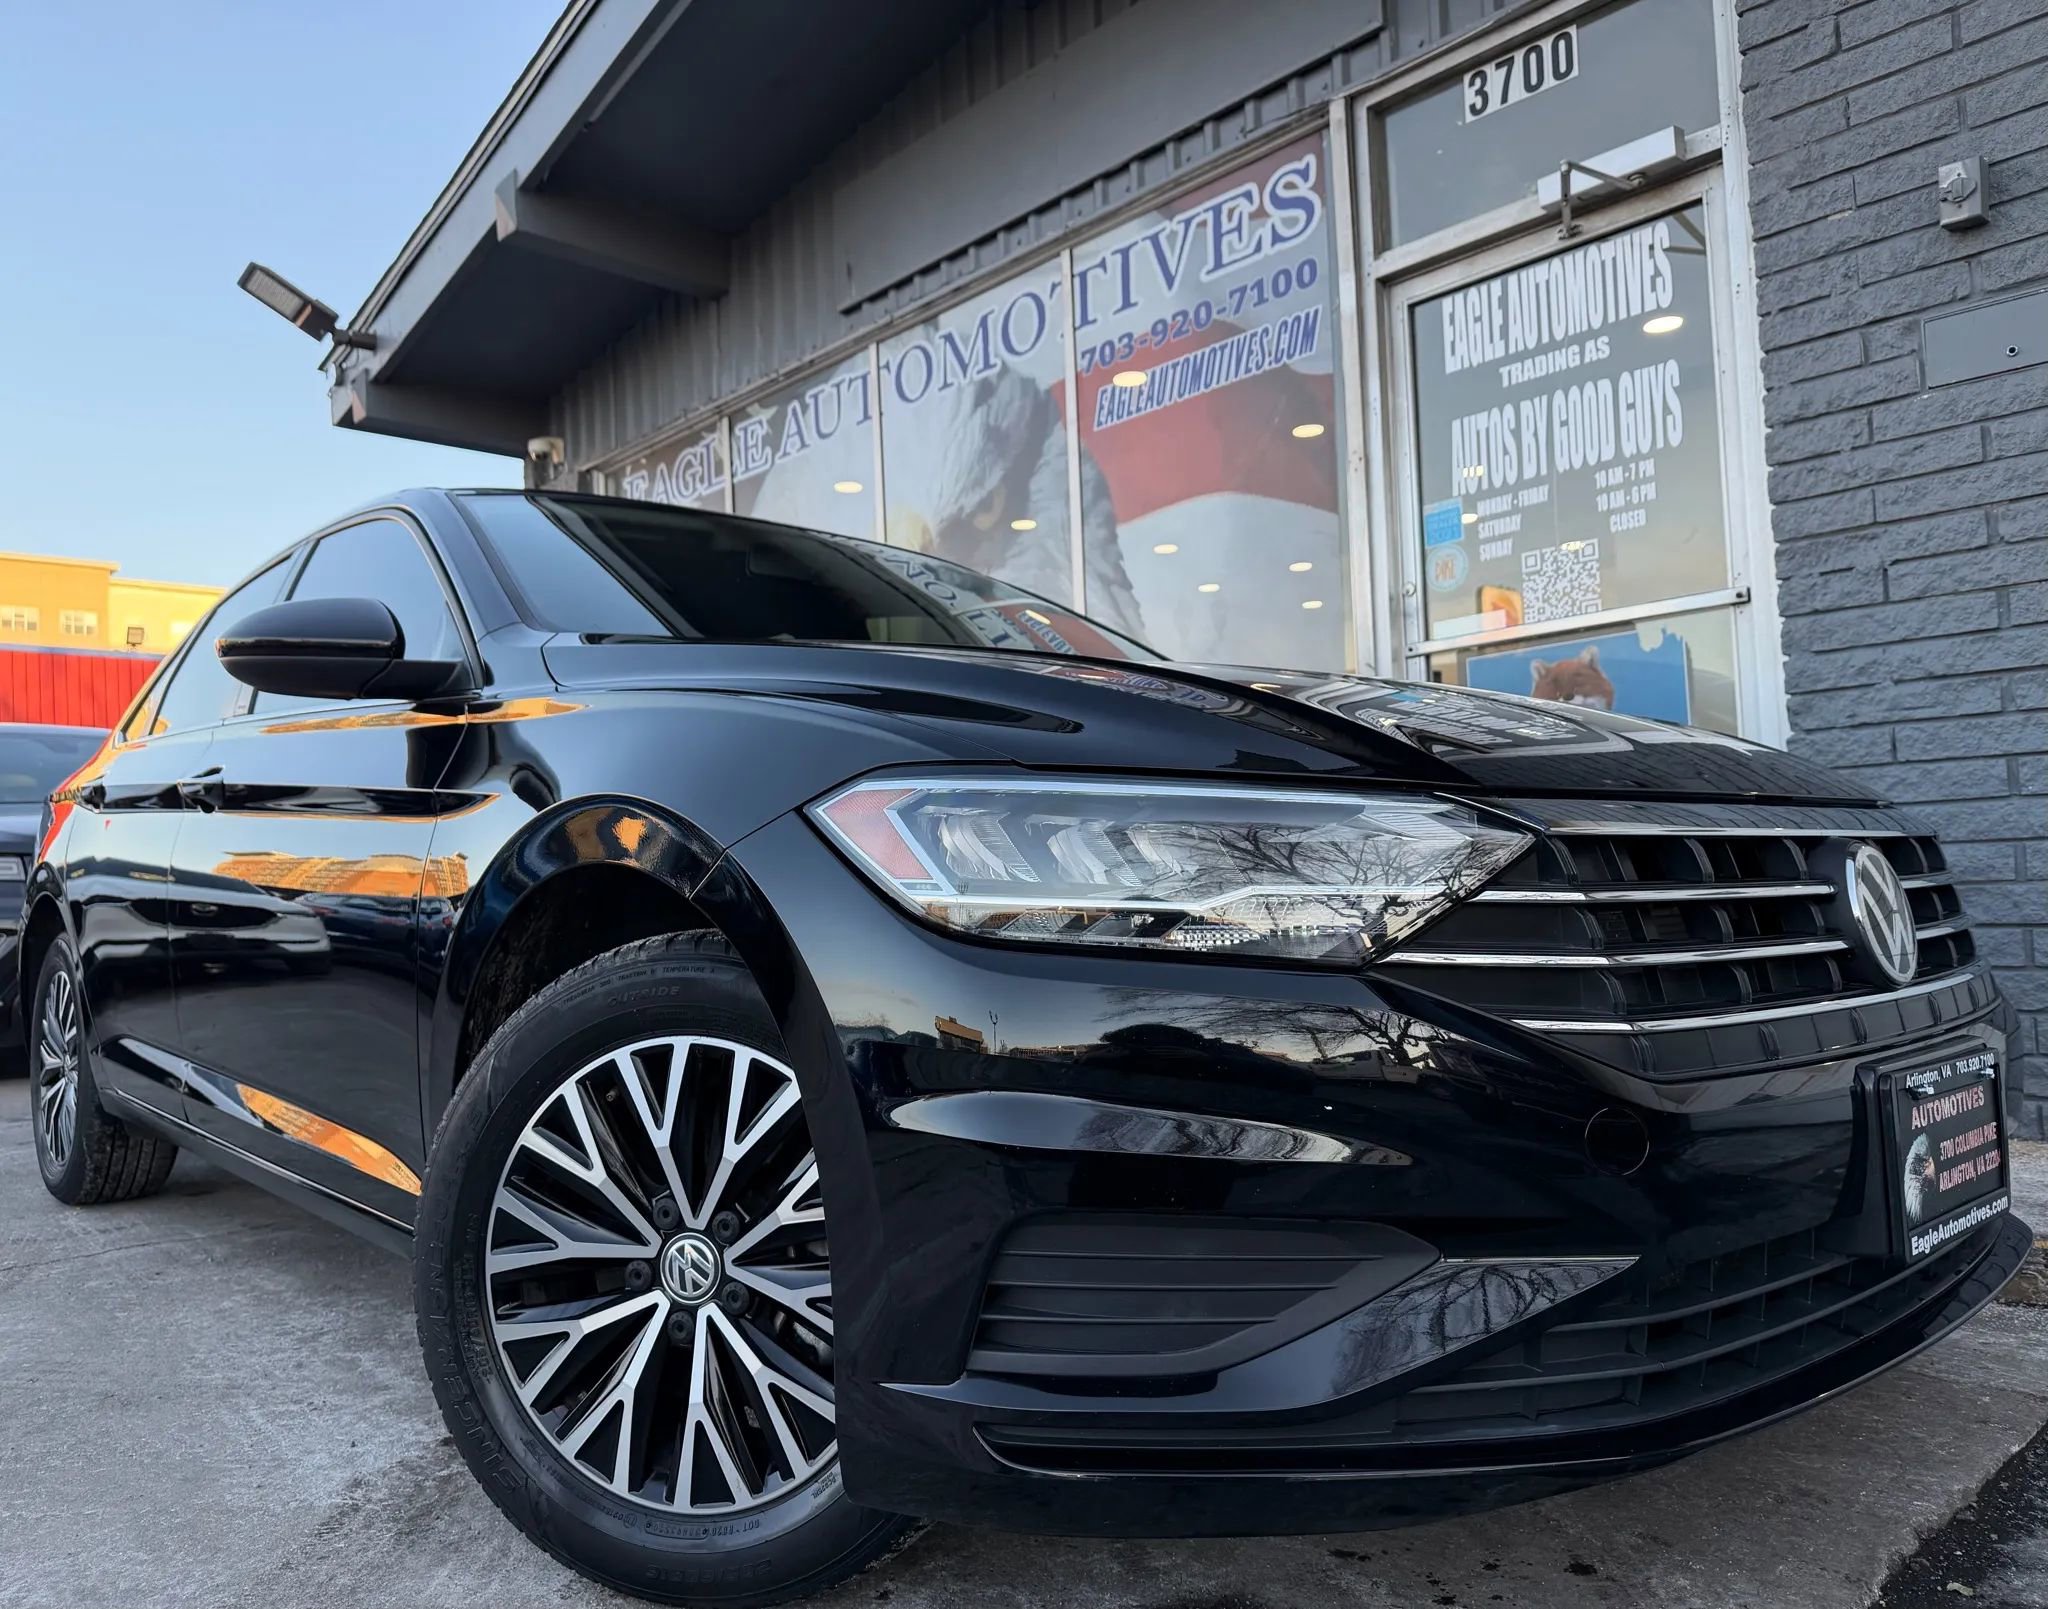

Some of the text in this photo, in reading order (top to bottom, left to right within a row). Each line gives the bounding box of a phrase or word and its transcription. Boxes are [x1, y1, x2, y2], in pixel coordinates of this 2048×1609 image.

[1468, 31, 1575, 117] 3700
[1081, 257, 1319, 374] 703-920-7100
[1441, 222, 1674, 375] EAGLE AUTOMOTIVES
[625, 154, 1322, 505] EAGLE AUTOMOTIVES
[1094, 305, 1322, 432] EAGLEAUTOMOTIVES.COM
[1499, 336, 1610, 388] TRADING AS
[1451, 359, 1683, 497] AUTOS BY GOOD GUYS
[1477, 513, 1522, 540] SATURDAY
[1609, 508, 1647, 533] CLOSED
[1479, 538, 1513, 563] SUNDAY
[608, 985, 680, 1008] OUTSIDE
[1905, 1052, 1995, 1089] Arlington, VA 703.920.7100
[1911, 1085, 1985, 1131] AUTOMOTIVES
[1955, 1126, 1984, 1156] COLUMBIA
[1983, 1121, 1998, 1144] PIKE
[1939, 1159, 1977, 1193] ARLINGTON,
[1975, 1155, 1985, 1176] VA
[1911, 1195, 2009, 1256] EagleAutomotives.com
